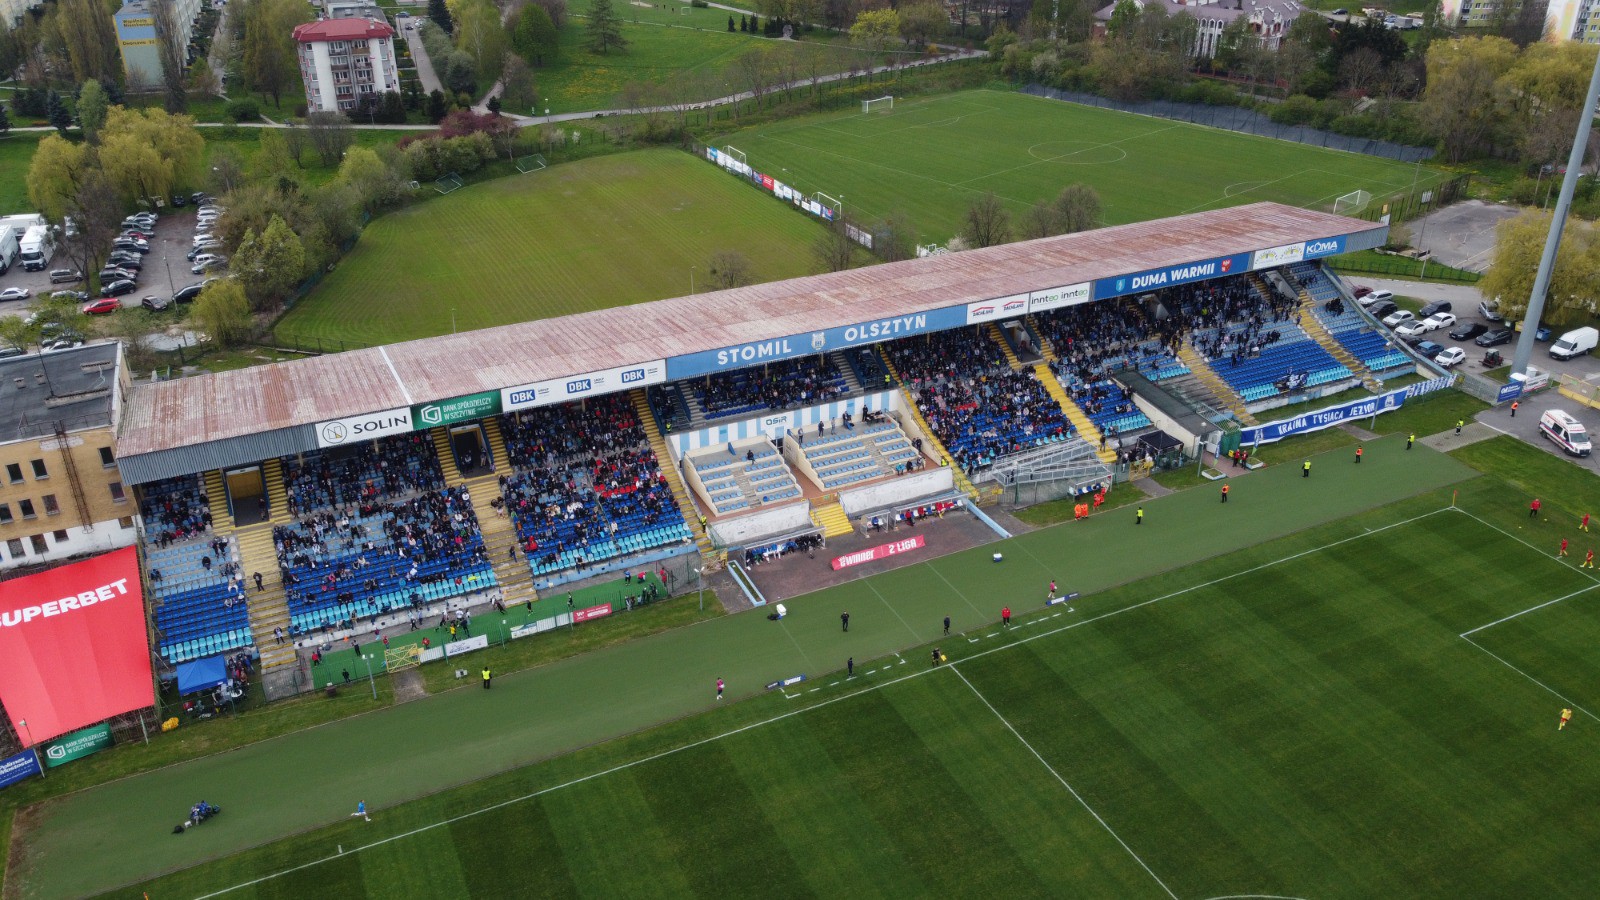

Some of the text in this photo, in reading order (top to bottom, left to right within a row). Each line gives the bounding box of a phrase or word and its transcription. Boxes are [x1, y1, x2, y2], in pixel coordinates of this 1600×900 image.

[1306, 241, 1338, 254] KOMA
[1131, 262, 1215, 290] DUMA WARMII
[717, 314, 927, 366] STOMIL OLSZTYN
[623, 370, 645, 383] DBK
[568, 380, 591, 393] DBK
[511, 390, 535, 403] DBK
[442, 404, 457, 412] BANK
[451, 408, 476, 419] SZCZYTNIE
[353, 415, 408, 434] SOLIN
[1277, 417, 1308, 435] KRAINA
[1349, 402, 1375, 416] JEZIOR
[888, 545, 895, 554] 2
[896, 538, 917, 552] LIGA
[0, 577, 127, 627] UPERBET
